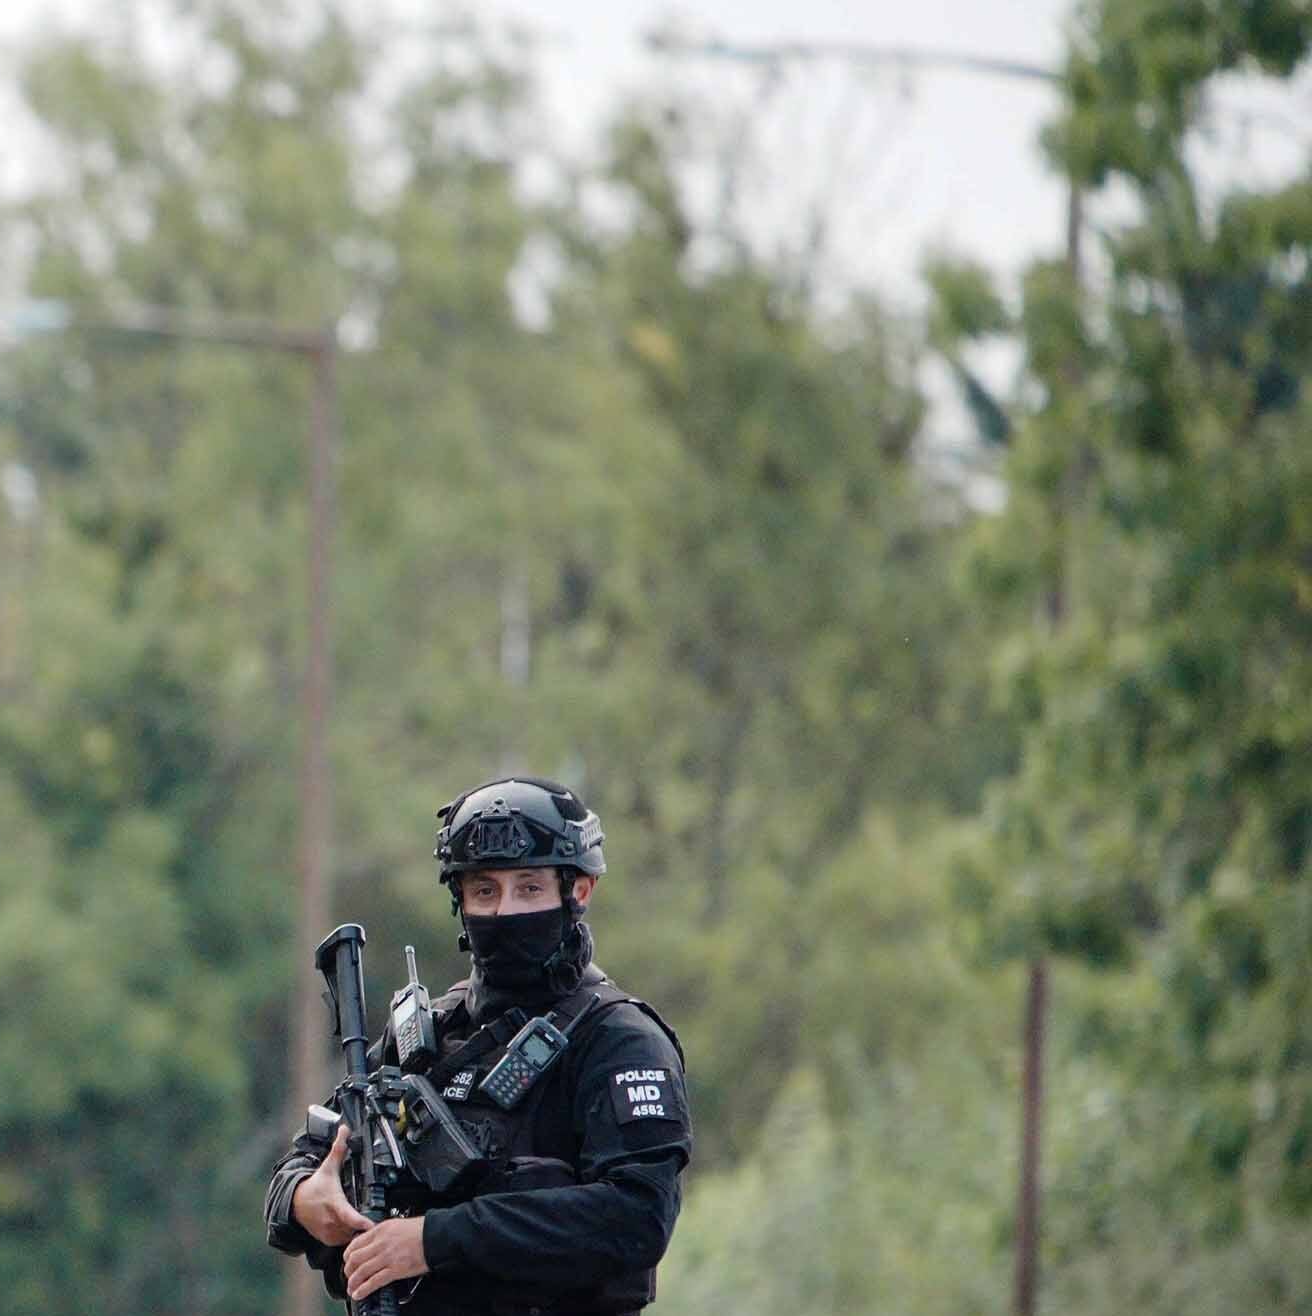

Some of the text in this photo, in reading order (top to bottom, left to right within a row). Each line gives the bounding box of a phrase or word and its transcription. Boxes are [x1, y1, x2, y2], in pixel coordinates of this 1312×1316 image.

[616, 1070, 666, 1085] POLICE
[440, 1087, 466, 1098] ICE
[627, 1085, 661, 1103] MD
[632, 1104, 665, 1117] 4582
